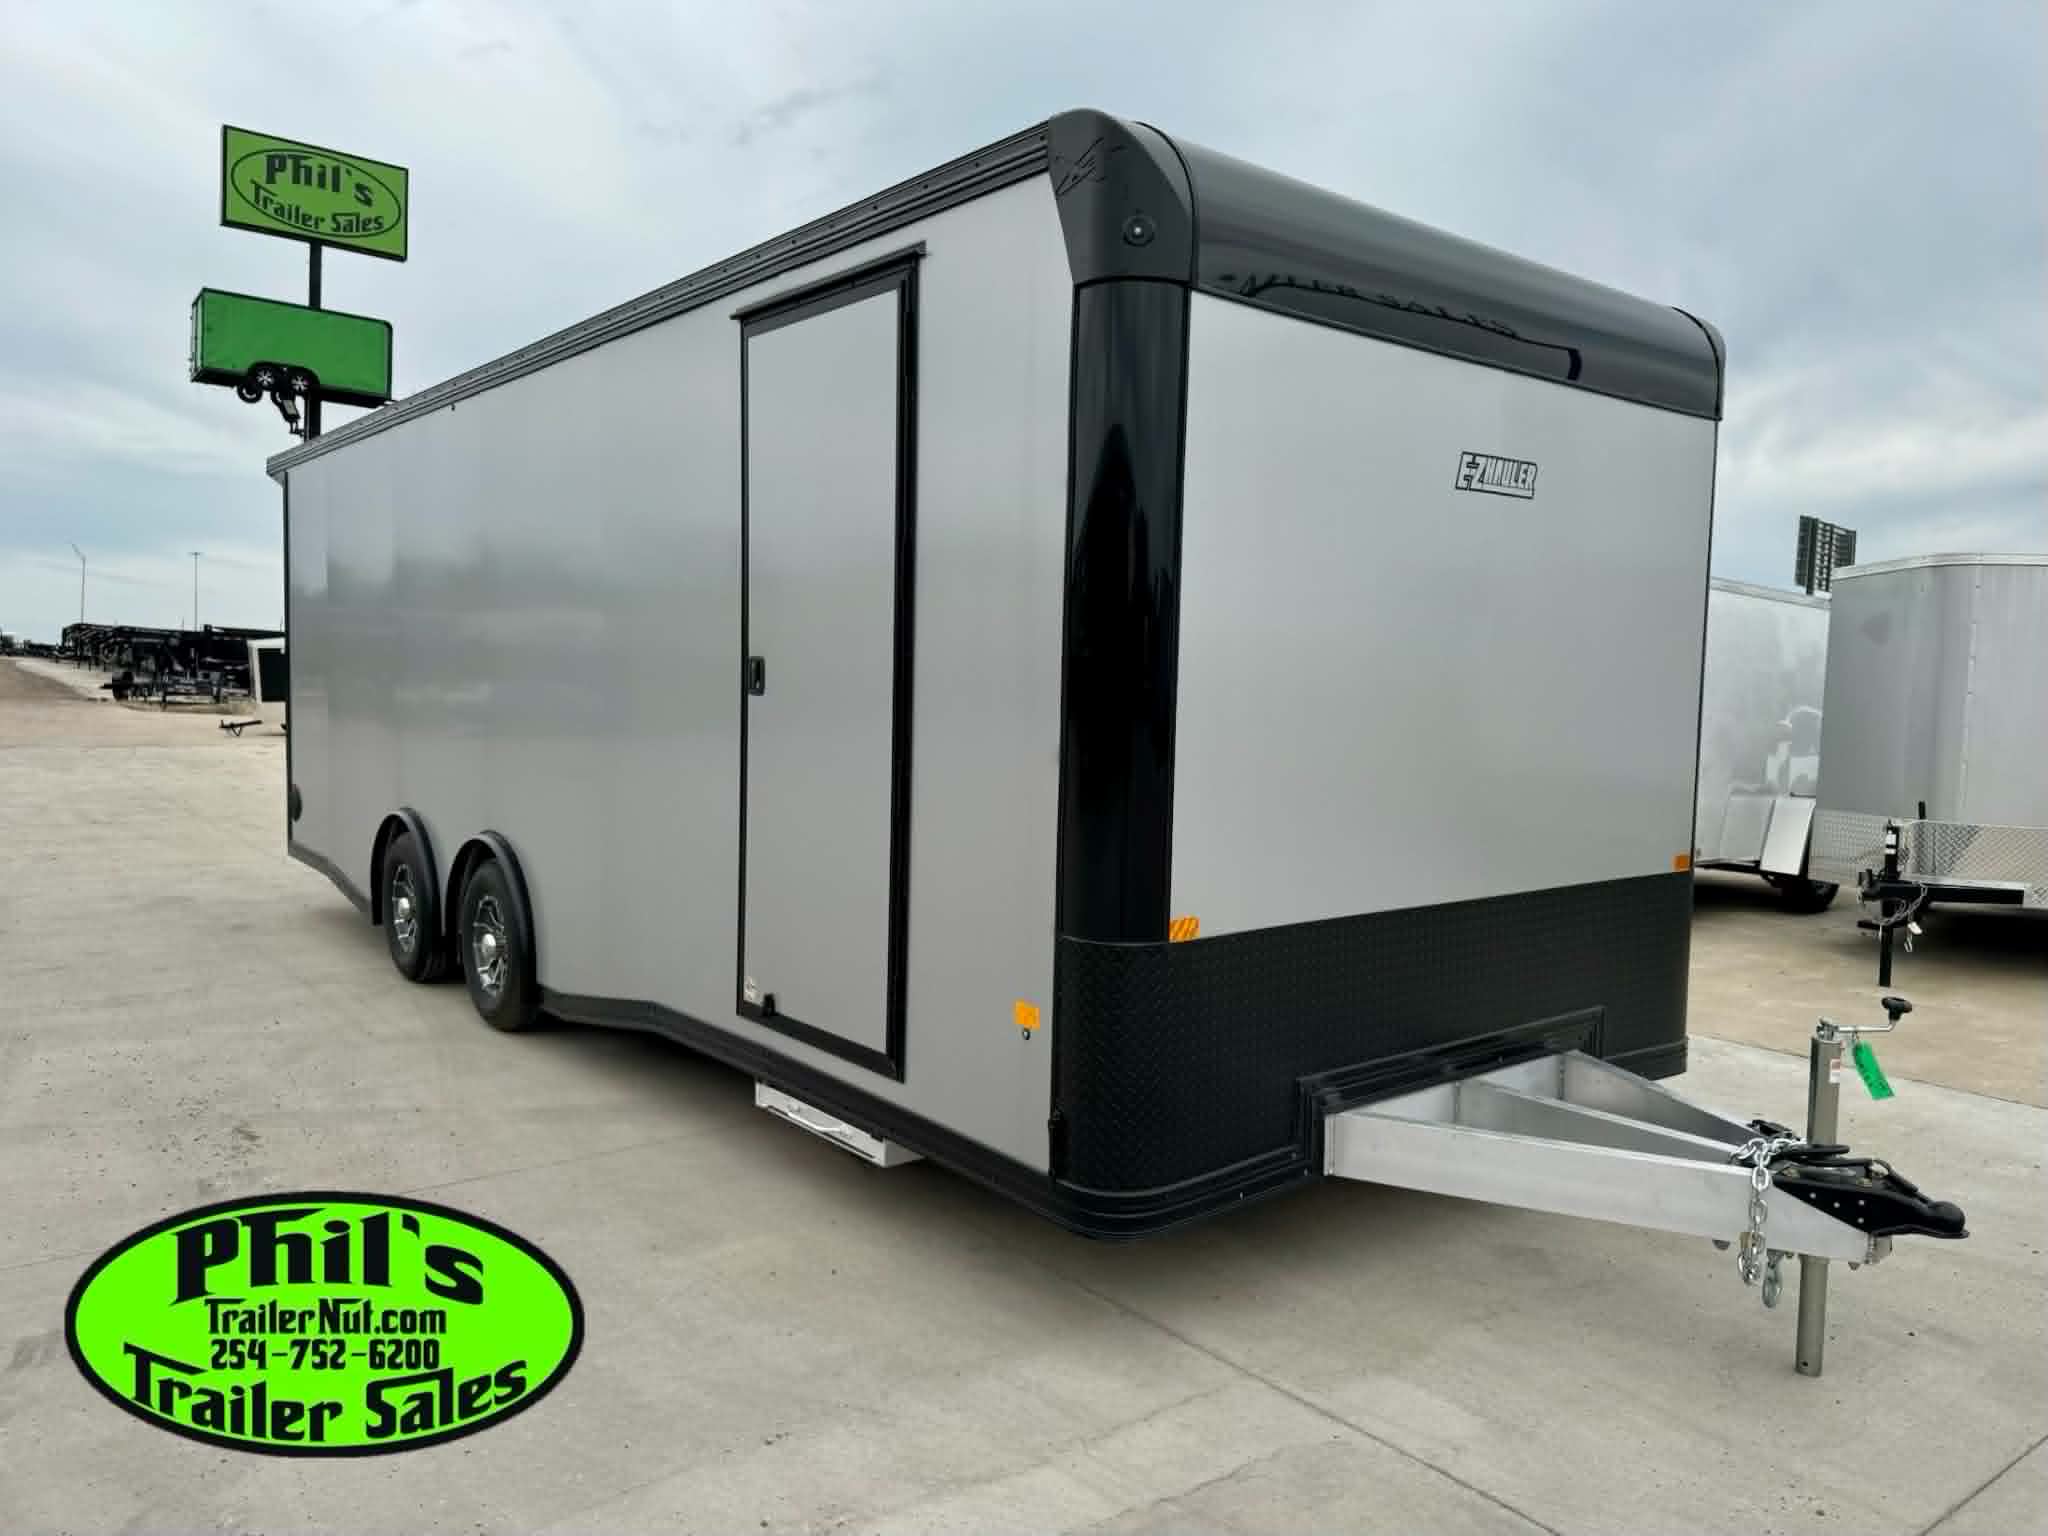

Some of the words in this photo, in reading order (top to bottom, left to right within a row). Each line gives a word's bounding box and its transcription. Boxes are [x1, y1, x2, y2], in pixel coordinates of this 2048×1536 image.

[250, 179, 325, 229] Trailer
[331, 211, 384, 233] Sales
[265, 152, 374, 208] Phil's
